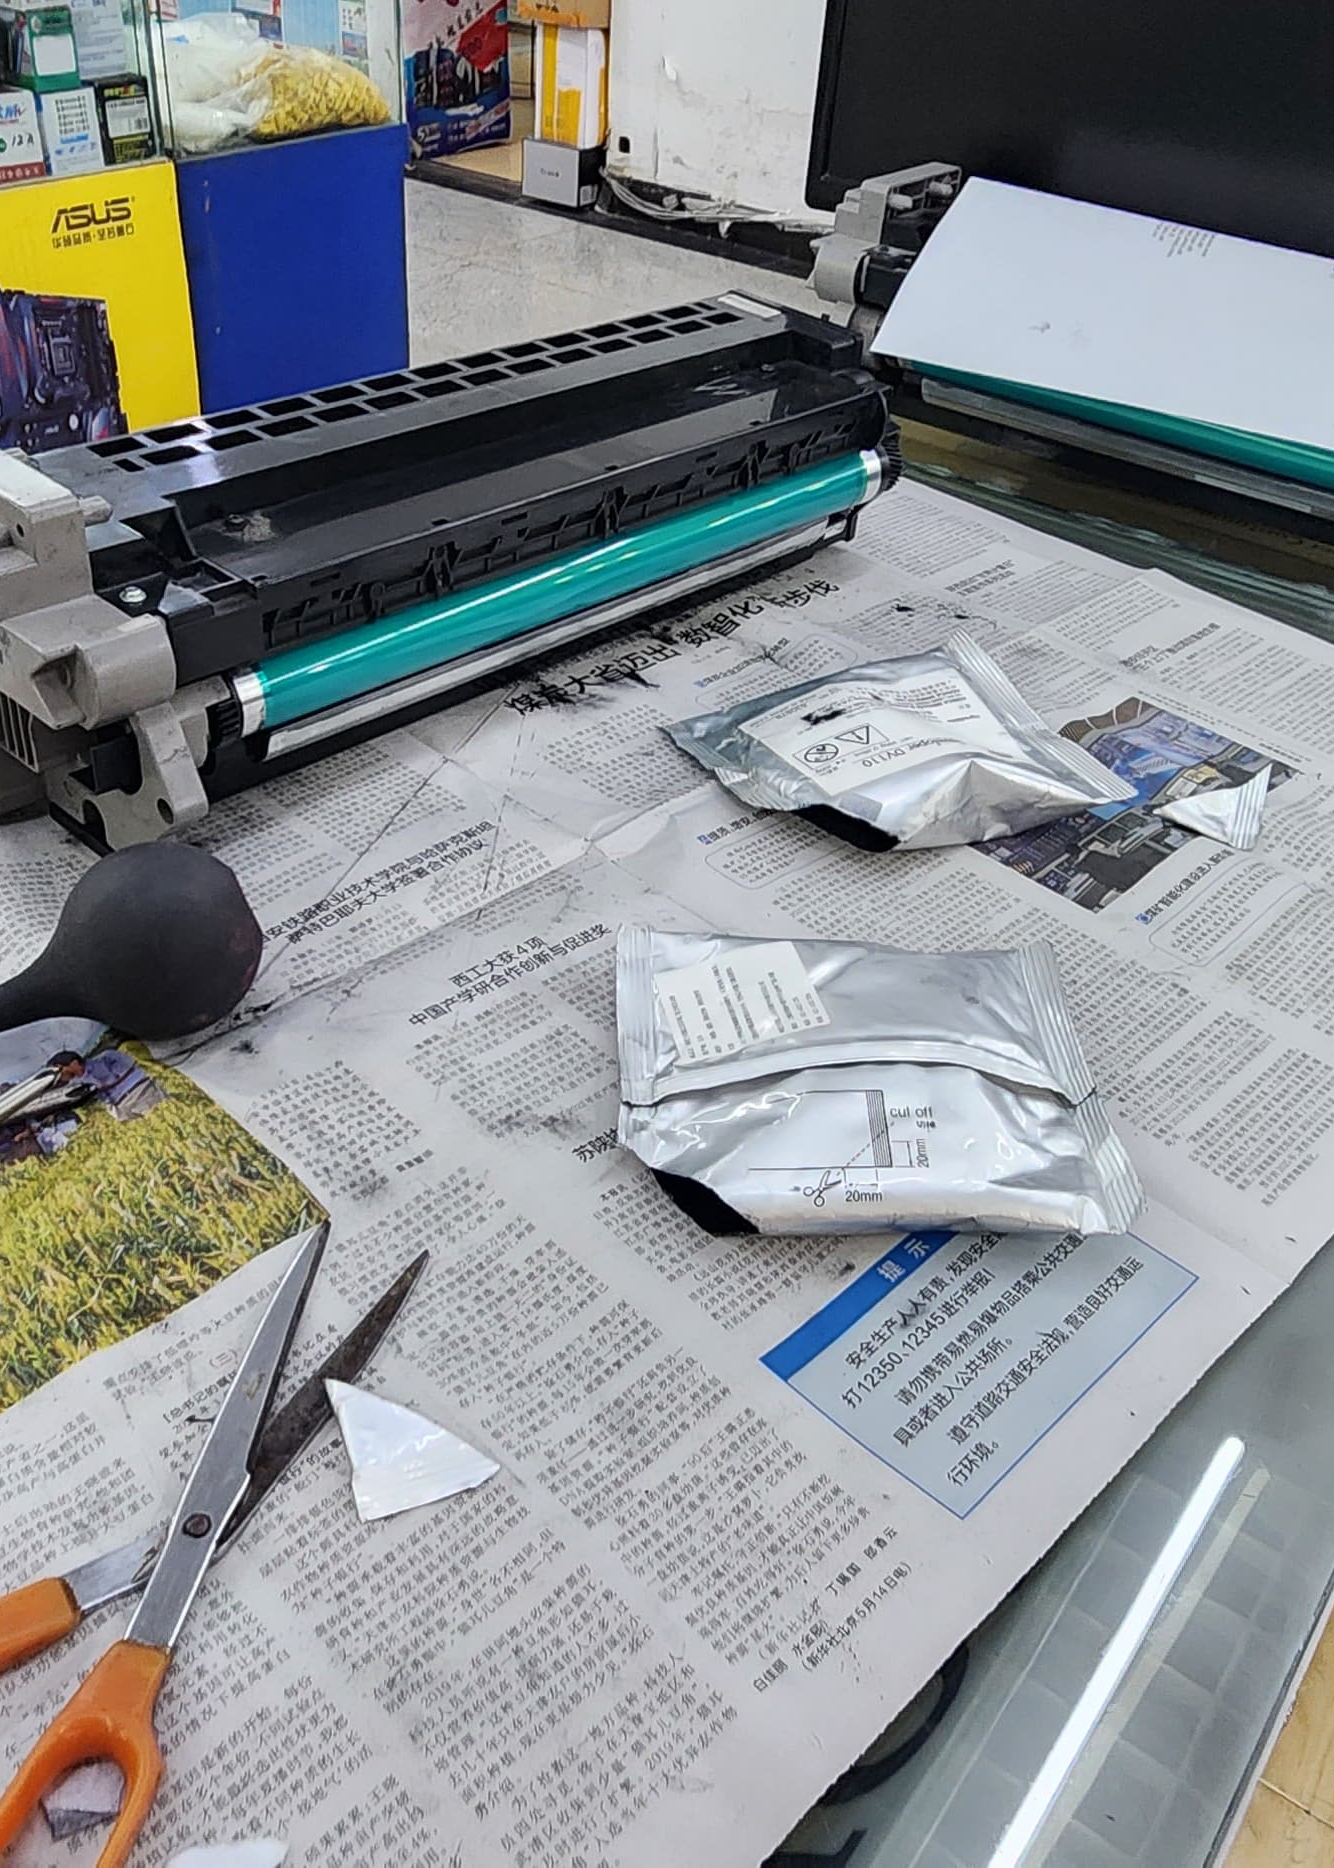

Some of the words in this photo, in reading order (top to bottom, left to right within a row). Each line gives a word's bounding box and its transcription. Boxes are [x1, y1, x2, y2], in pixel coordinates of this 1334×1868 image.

[51, 197, 136, 234] ASUS
[408, 922, 611, 1028] 中国产学研合作创新与促进奖
[450, 935, 547, 989] 西工大获4项
[889, 1105, 911, 1119] cut
[914, 1104, 934, 1119] off
[916, 1138, 930, 1169] 20mm
[844, 1188, 884, 1204] 20mm
[895, 1231, 1087, 1408] 请勿携带易燃易爆物品搭乘公共交通
[892, 1336, 1014, 1448] 具或者进入公共场所。
[801, 1561, 914, 1673] (新华社北京6月14日电)
